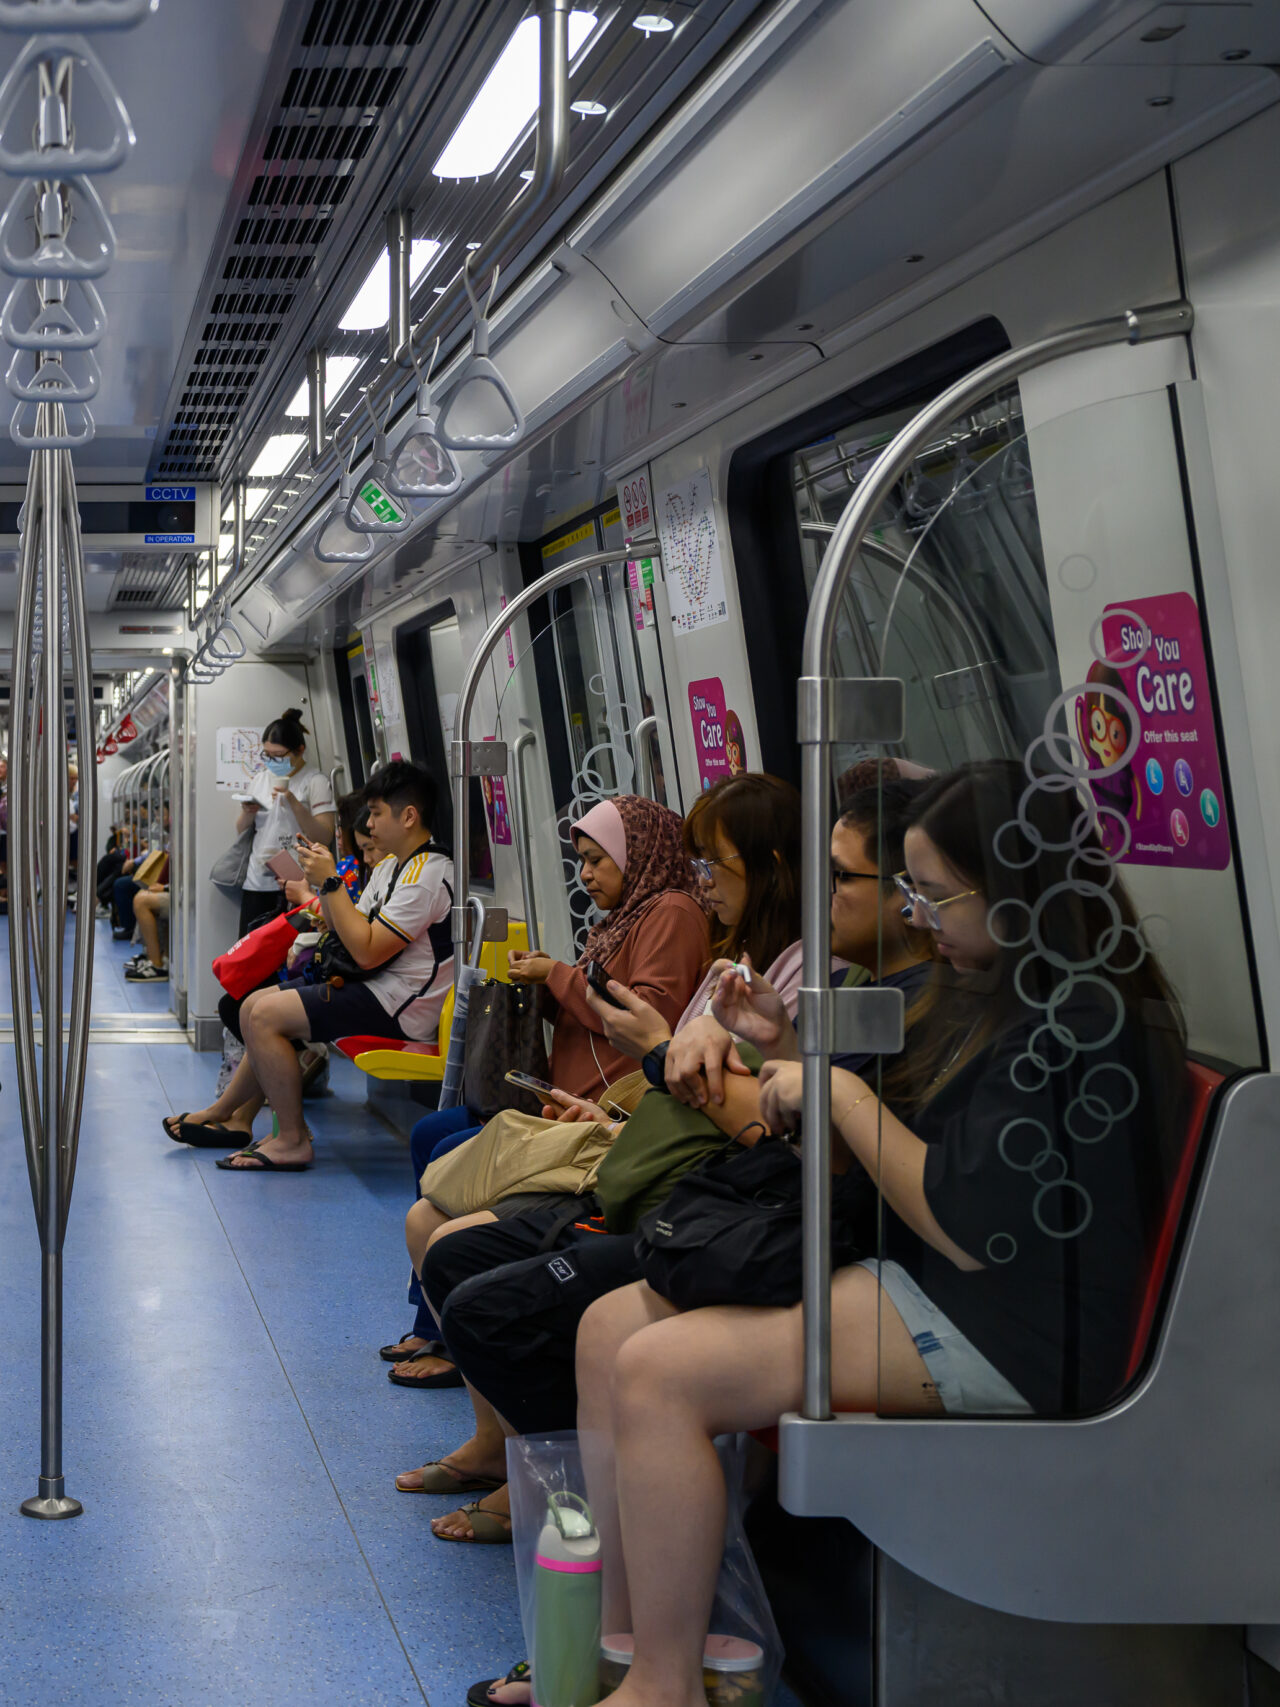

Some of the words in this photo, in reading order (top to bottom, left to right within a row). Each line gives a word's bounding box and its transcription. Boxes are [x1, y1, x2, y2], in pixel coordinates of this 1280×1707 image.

[151, 488, 190, 500] CCTV
[155, 535, 192, 543] OPERATION
[1155, 637, 1180, 662] You
[1137, 665, 1195, 713] Care
[693, 695, 706, 711] Show
[706, 702, 717, 718] You
[701, 719, 723, 748] Care
[1144, 730, 1164, 743] Offer
[1164, 729, 1180, 743] this
[1180, 729, 1198, 742] seat
